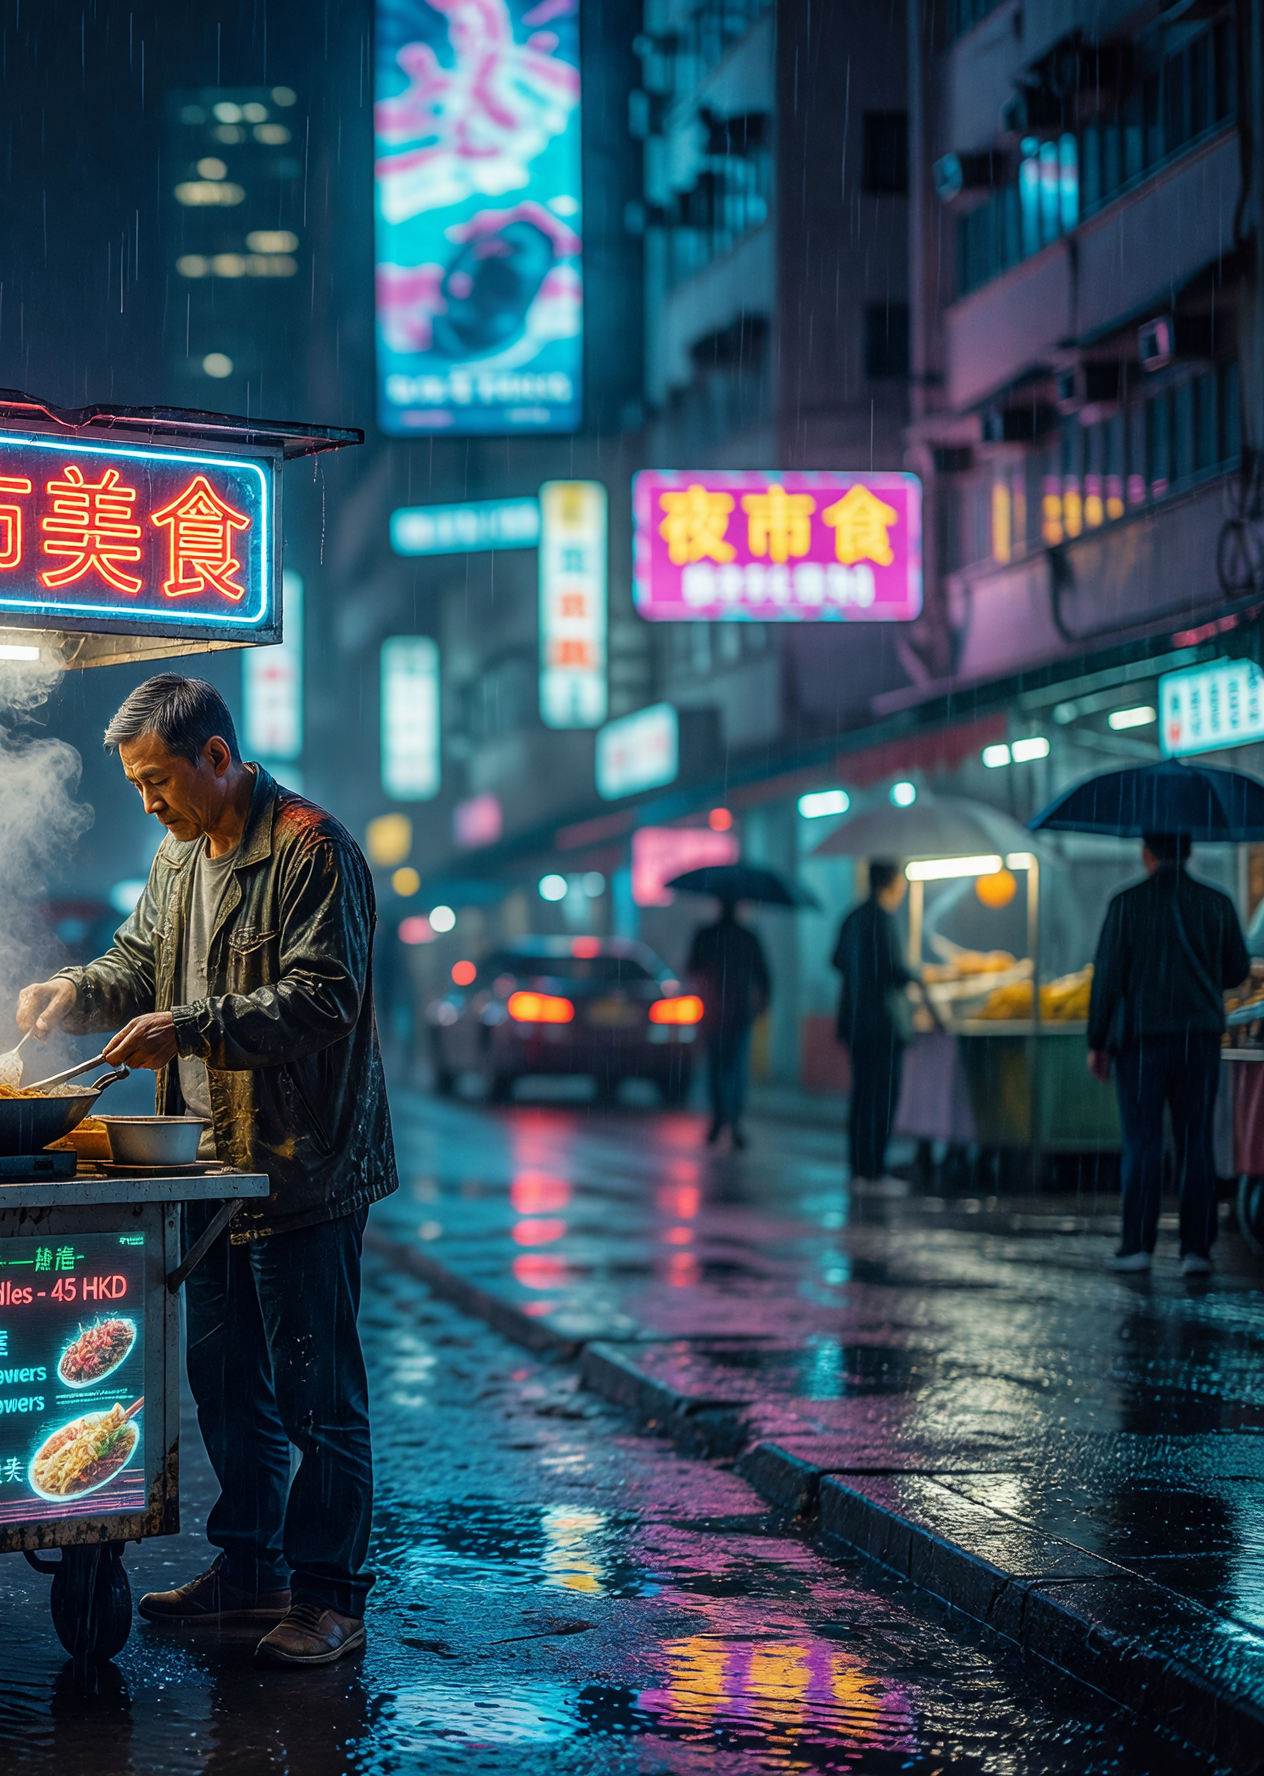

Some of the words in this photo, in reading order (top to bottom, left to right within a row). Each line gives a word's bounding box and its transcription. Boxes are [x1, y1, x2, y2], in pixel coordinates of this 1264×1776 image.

[658, 483, 899, 567] 夜市食
[51, 1277, 77, 1302] 45
[82, 1275, 127, 1301] HKD
